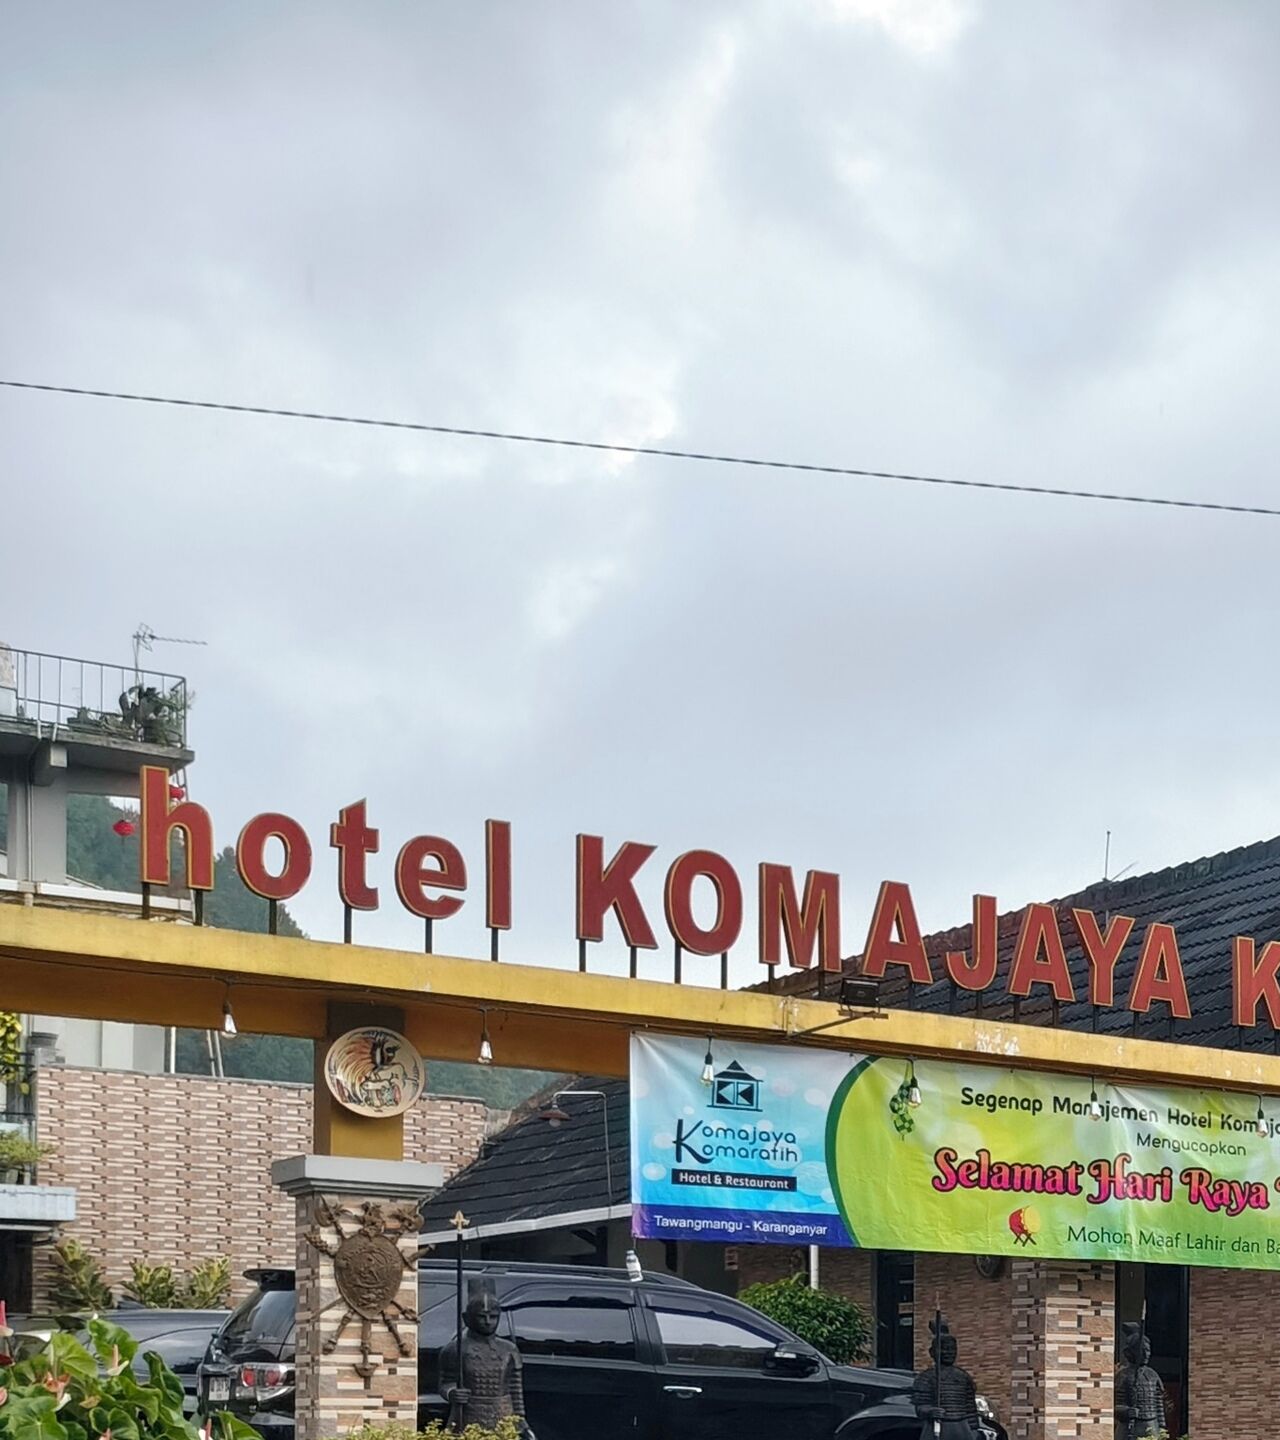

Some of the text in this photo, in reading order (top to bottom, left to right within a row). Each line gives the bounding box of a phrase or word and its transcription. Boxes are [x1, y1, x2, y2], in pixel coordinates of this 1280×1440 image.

[139, 765, 512, 931] hotel
[576, 833, 1192, 1019] KOMAJAYA
[961, 1087, 1043, 1115] Segenap
[1168, 1108, 1211, 1129] Hotel
[672, 1119, 797, 1150] Komajaya
[1136, 1132, 1247, 1157] Mengucapkan
[679, 1172, 789, 1190] Hotel & Restaurant
[932, 1147, 1085, 1196] Selamat
[1086, 1153, 1173, 1205] Hari
[1180, 1167, 1270, 1217] Raya
[654, 1215, 743, 1233] Tawangmangu
[753, 1220, 828, 1237] Karanganyar
[1067, 1226, 1132, 1245] Mohon
[1139, 1230, 1182, 1248] Maaf
[1186, 1233, 1226, 1252] Lahir
[1231, 1237, 1260, 1253] dan
